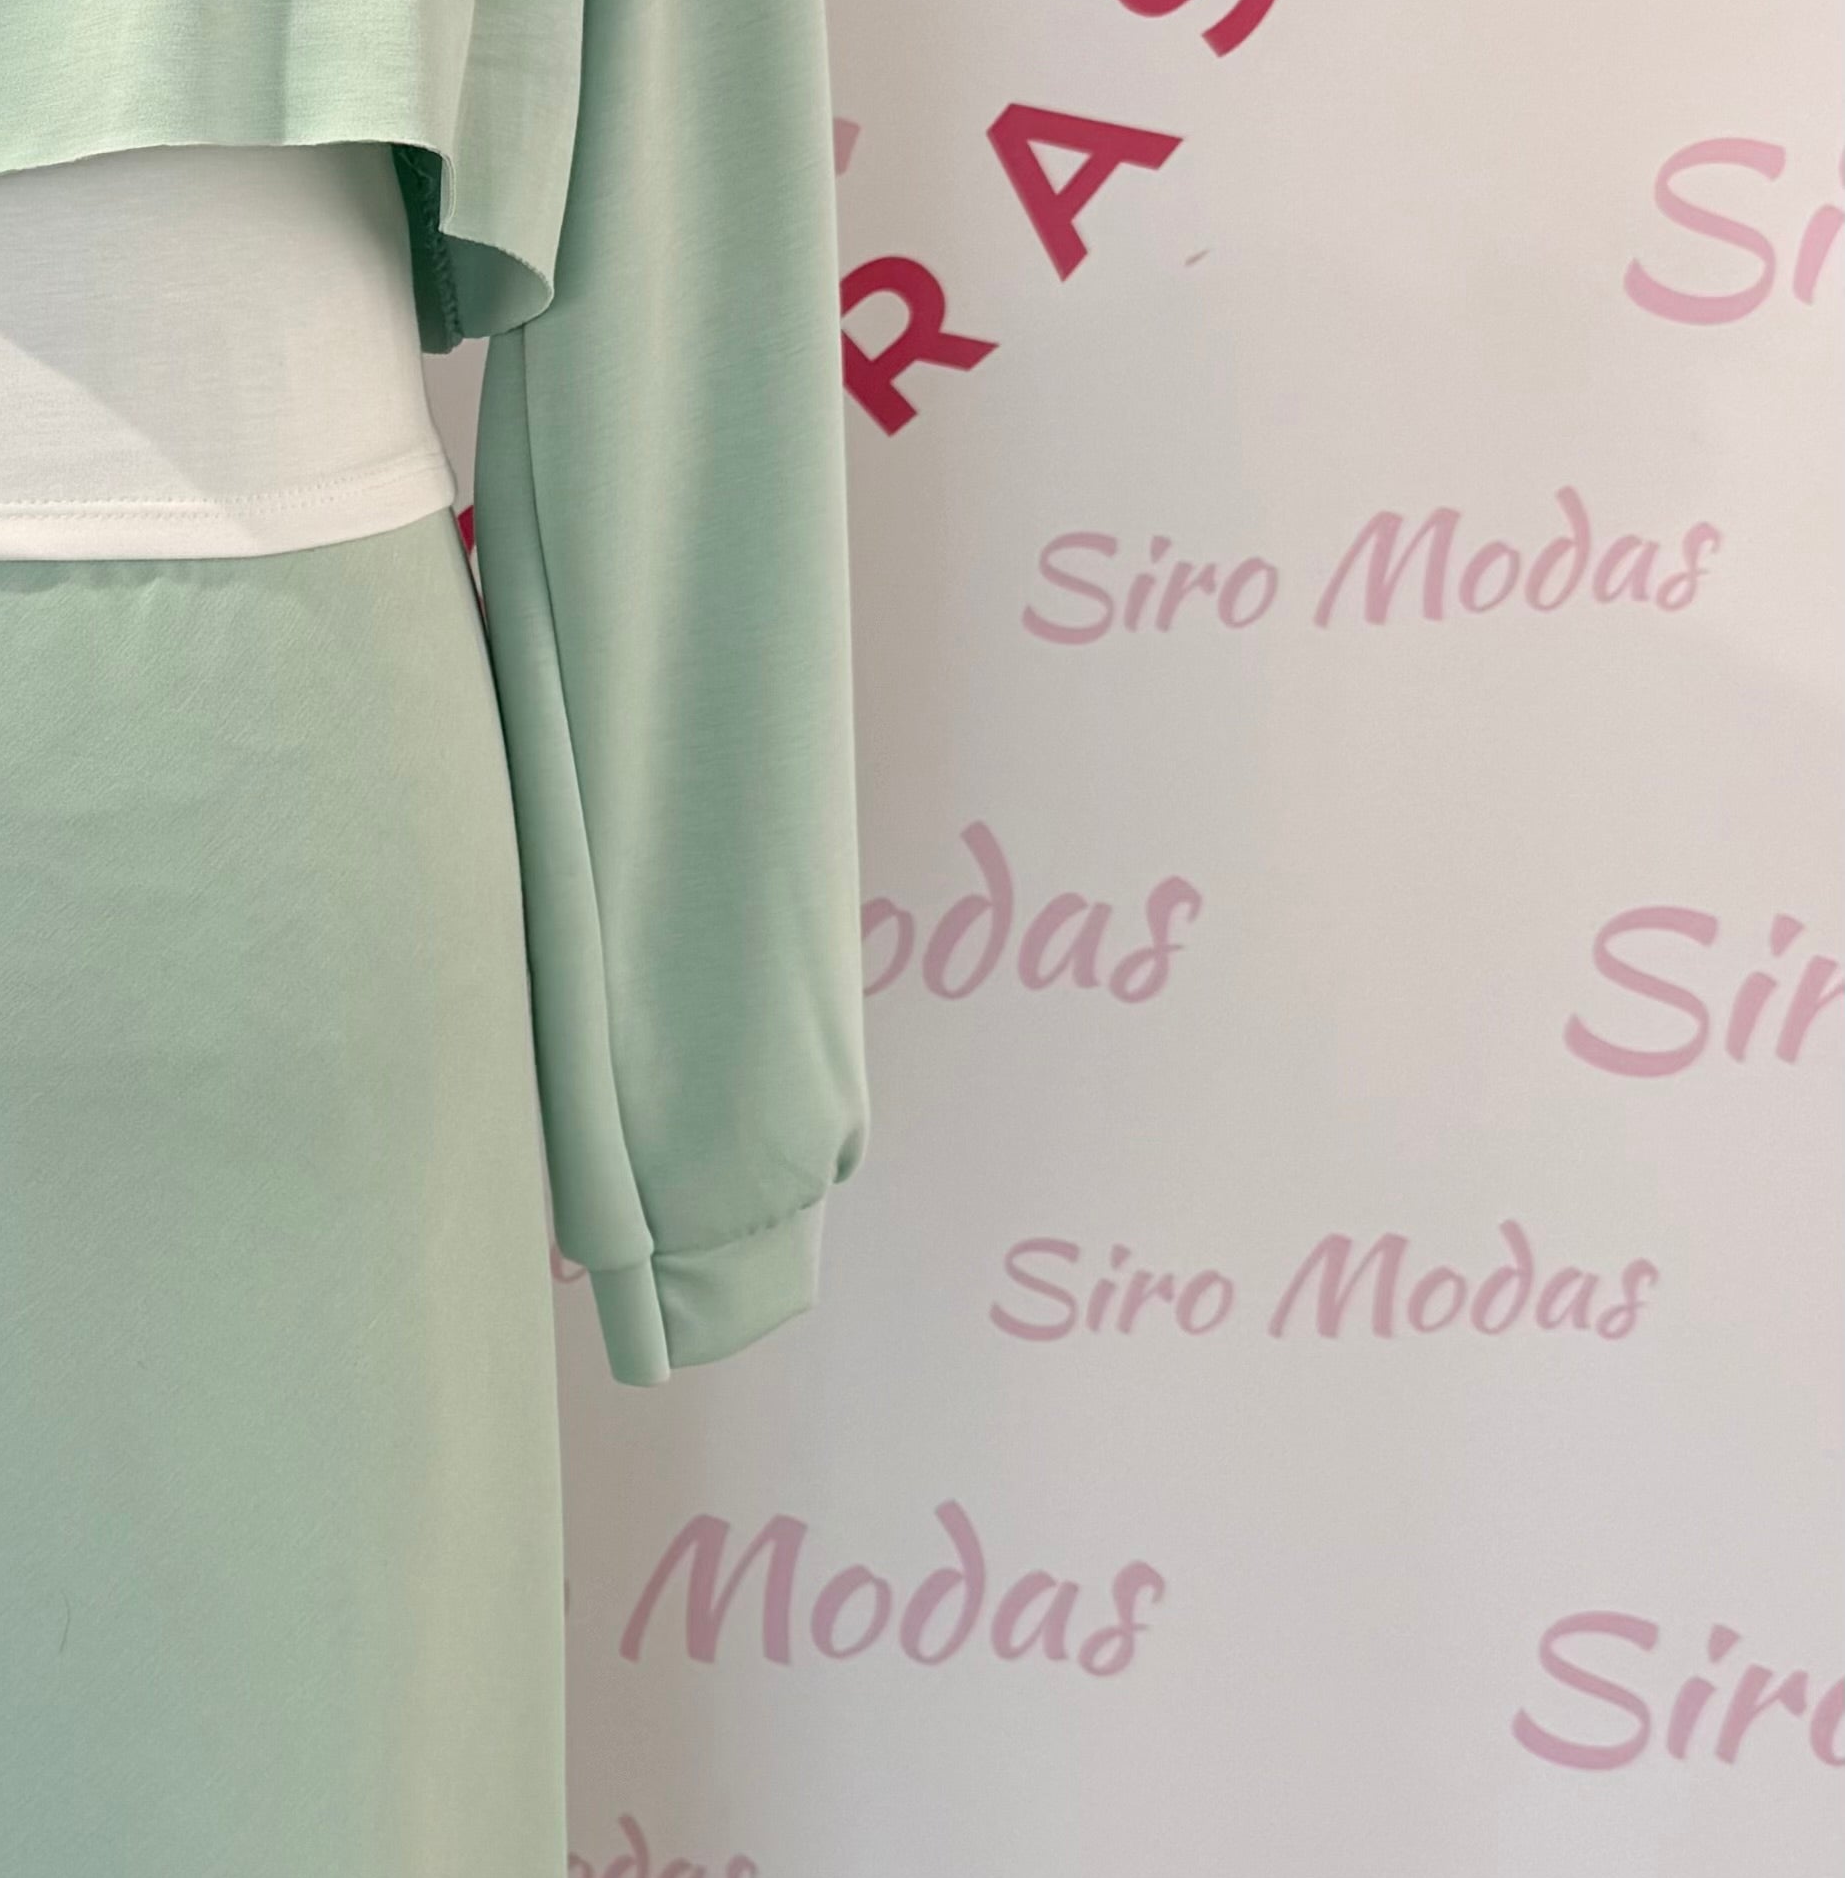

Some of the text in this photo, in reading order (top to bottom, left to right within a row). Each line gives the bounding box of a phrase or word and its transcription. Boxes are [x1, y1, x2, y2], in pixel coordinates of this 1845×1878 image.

[1021, 486, 1721, 647] Siro Modas
[862, 821, 1204, 1005] odas
[1566, 906, 1845, 1079] Sir
[990, 1220, 1660, 1343] Siro Modas
[620, 1502, 1165, 1677] Modas
